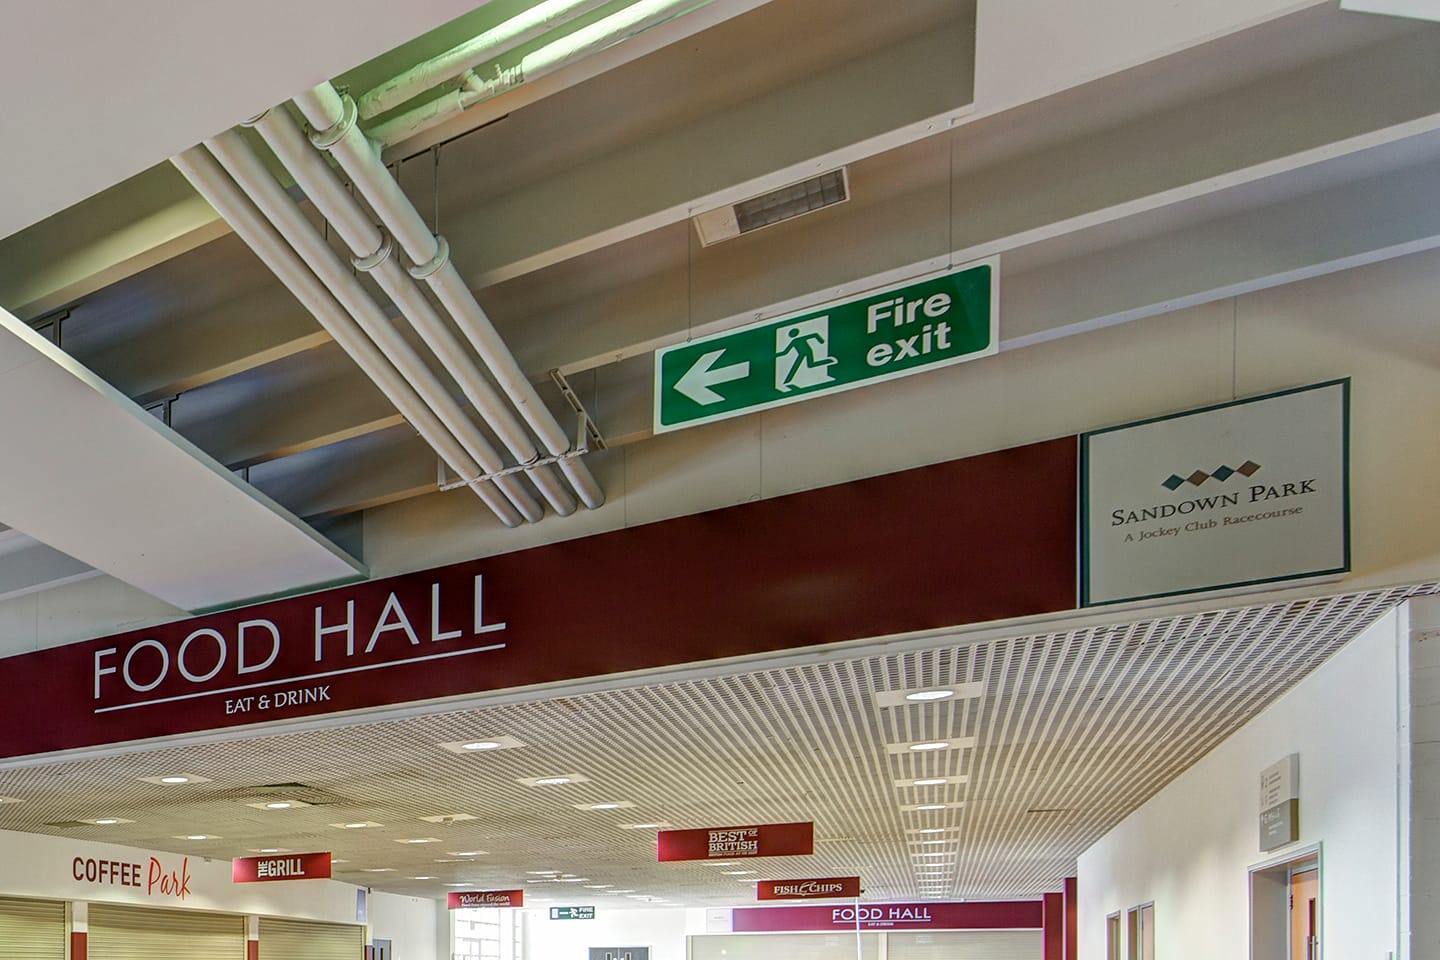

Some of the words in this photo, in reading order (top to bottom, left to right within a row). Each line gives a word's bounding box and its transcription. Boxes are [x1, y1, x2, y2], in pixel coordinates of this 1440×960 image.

[867, 292, 952, 334] Fire
[866, 321, 952, 367] exit
[1111, 492, 1240, 526] SANDOWN
[1248, 478, 1317, 503] PARK
[1123, 533, 1134, 543] A
[1138, 526, 1181, 542] Jockey
[1184, 519, 1218, 532] Club
[1223, 505, 1304, 526] Racecourse
[94, 618, 281, 699] FOOD
[314, 574, 507, 662] HALL
[224, 696, 255, 714] EAT
[258, 694, 271, 710] &
[274, 685, 331, 708] DRINK
[708, 831, 747, 843] BEST
[708, 840, 758, 852] BRITISH
[72, 856, 142, 888] COFFEE
[147, 856, 192, 900] Park
[258, 860, 268, 878] THE
[268, 858, 305, 877] GRILL
[459, 893, 484, 904] World
[486, 893, 510, 903] Fusion
[773, 885, 799, 894] FISH
[808, 883, 843, 892] CHIPS
[832, 908, 883, 921] FOOD
[889, 907, 931, 920] HALL
